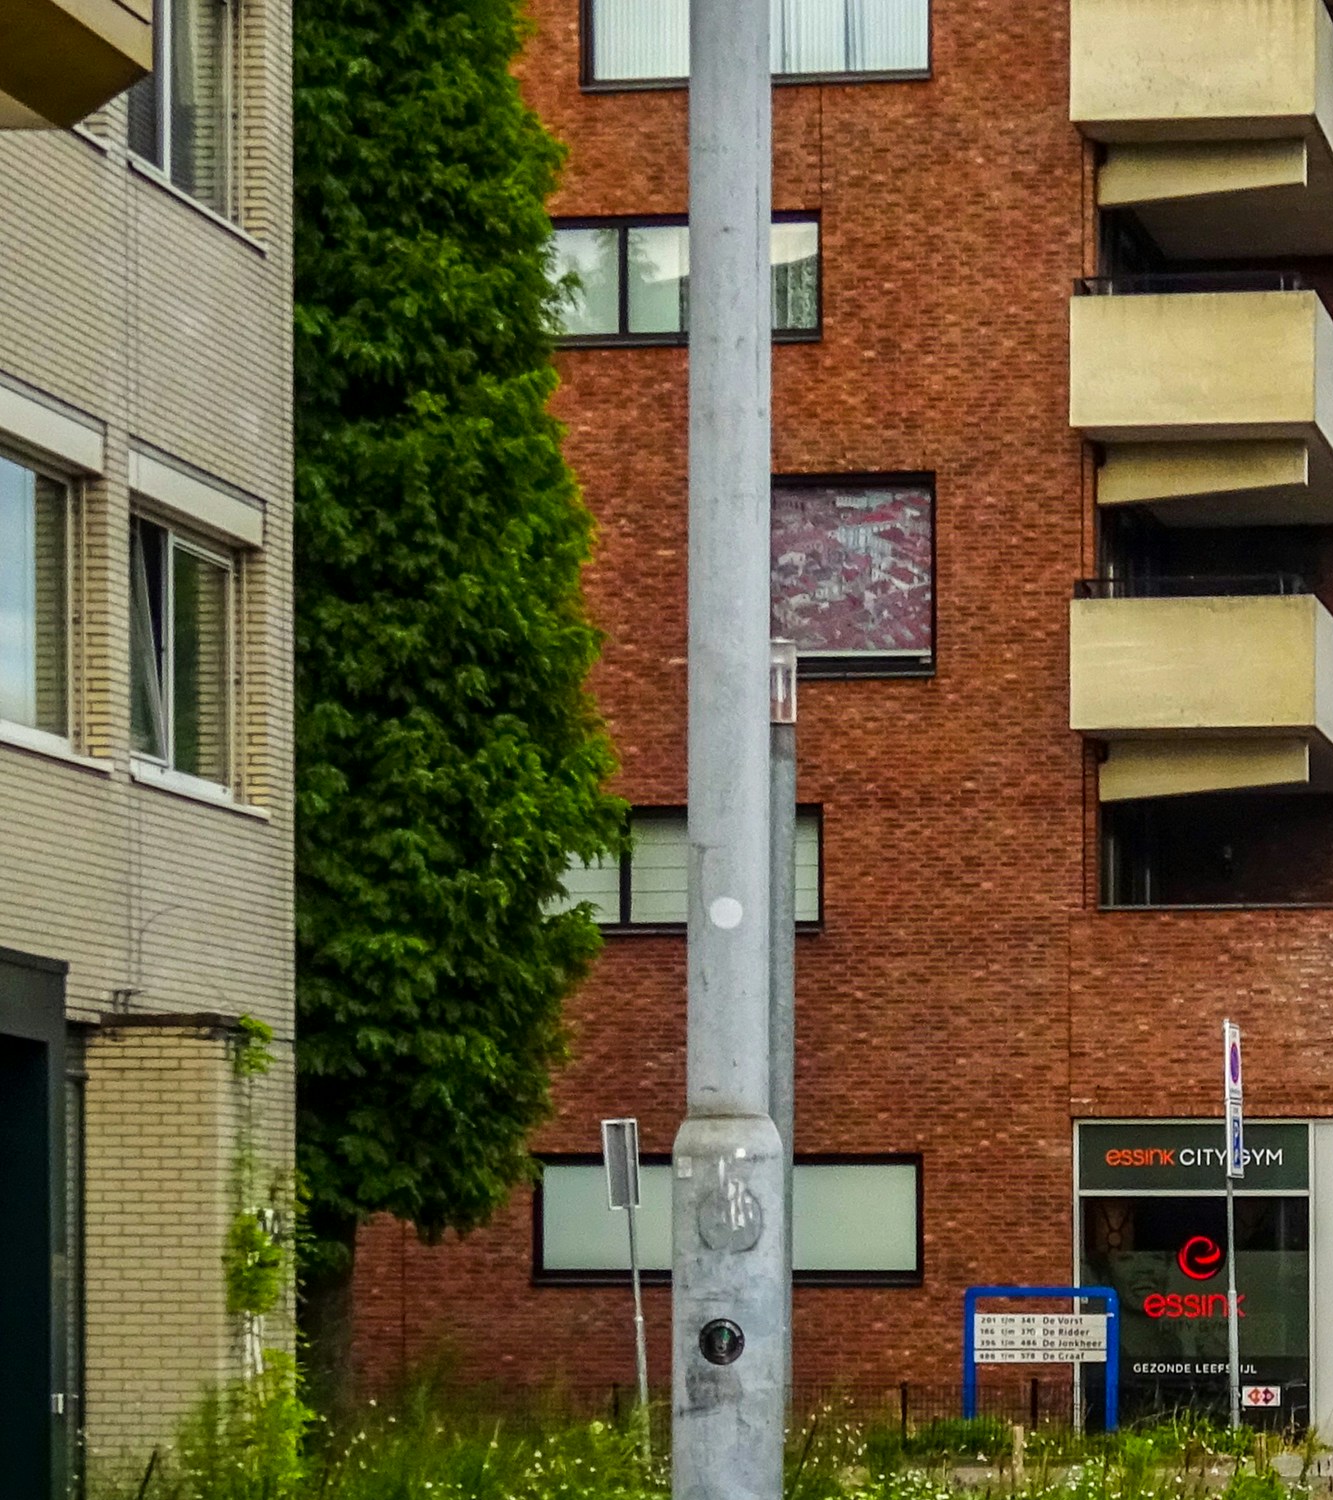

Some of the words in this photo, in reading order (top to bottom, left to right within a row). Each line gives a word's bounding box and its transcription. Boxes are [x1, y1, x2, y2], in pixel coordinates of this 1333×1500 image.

[1105, 1148, 1176, 1166] essink
[1179, 1148, 1227, 1166] CITY
[1043, 1317, 1055, 1325] De
[1058, 1317, 1084, 1325] Vorst
[1043, 1328, 1055, 1336] De
[1058, 1328, 1090, 1336] Ridder
[1058, 1339, 1102, 1347] Jonkheer
[1043, 1352, 1055, 1360] De
[1058, 1352, 1085, 1361] Graaf
[1133, 1363, 1191, 1374] GEZONDE
[1195, 1363, 1258, 1374] LEEFSIJL
